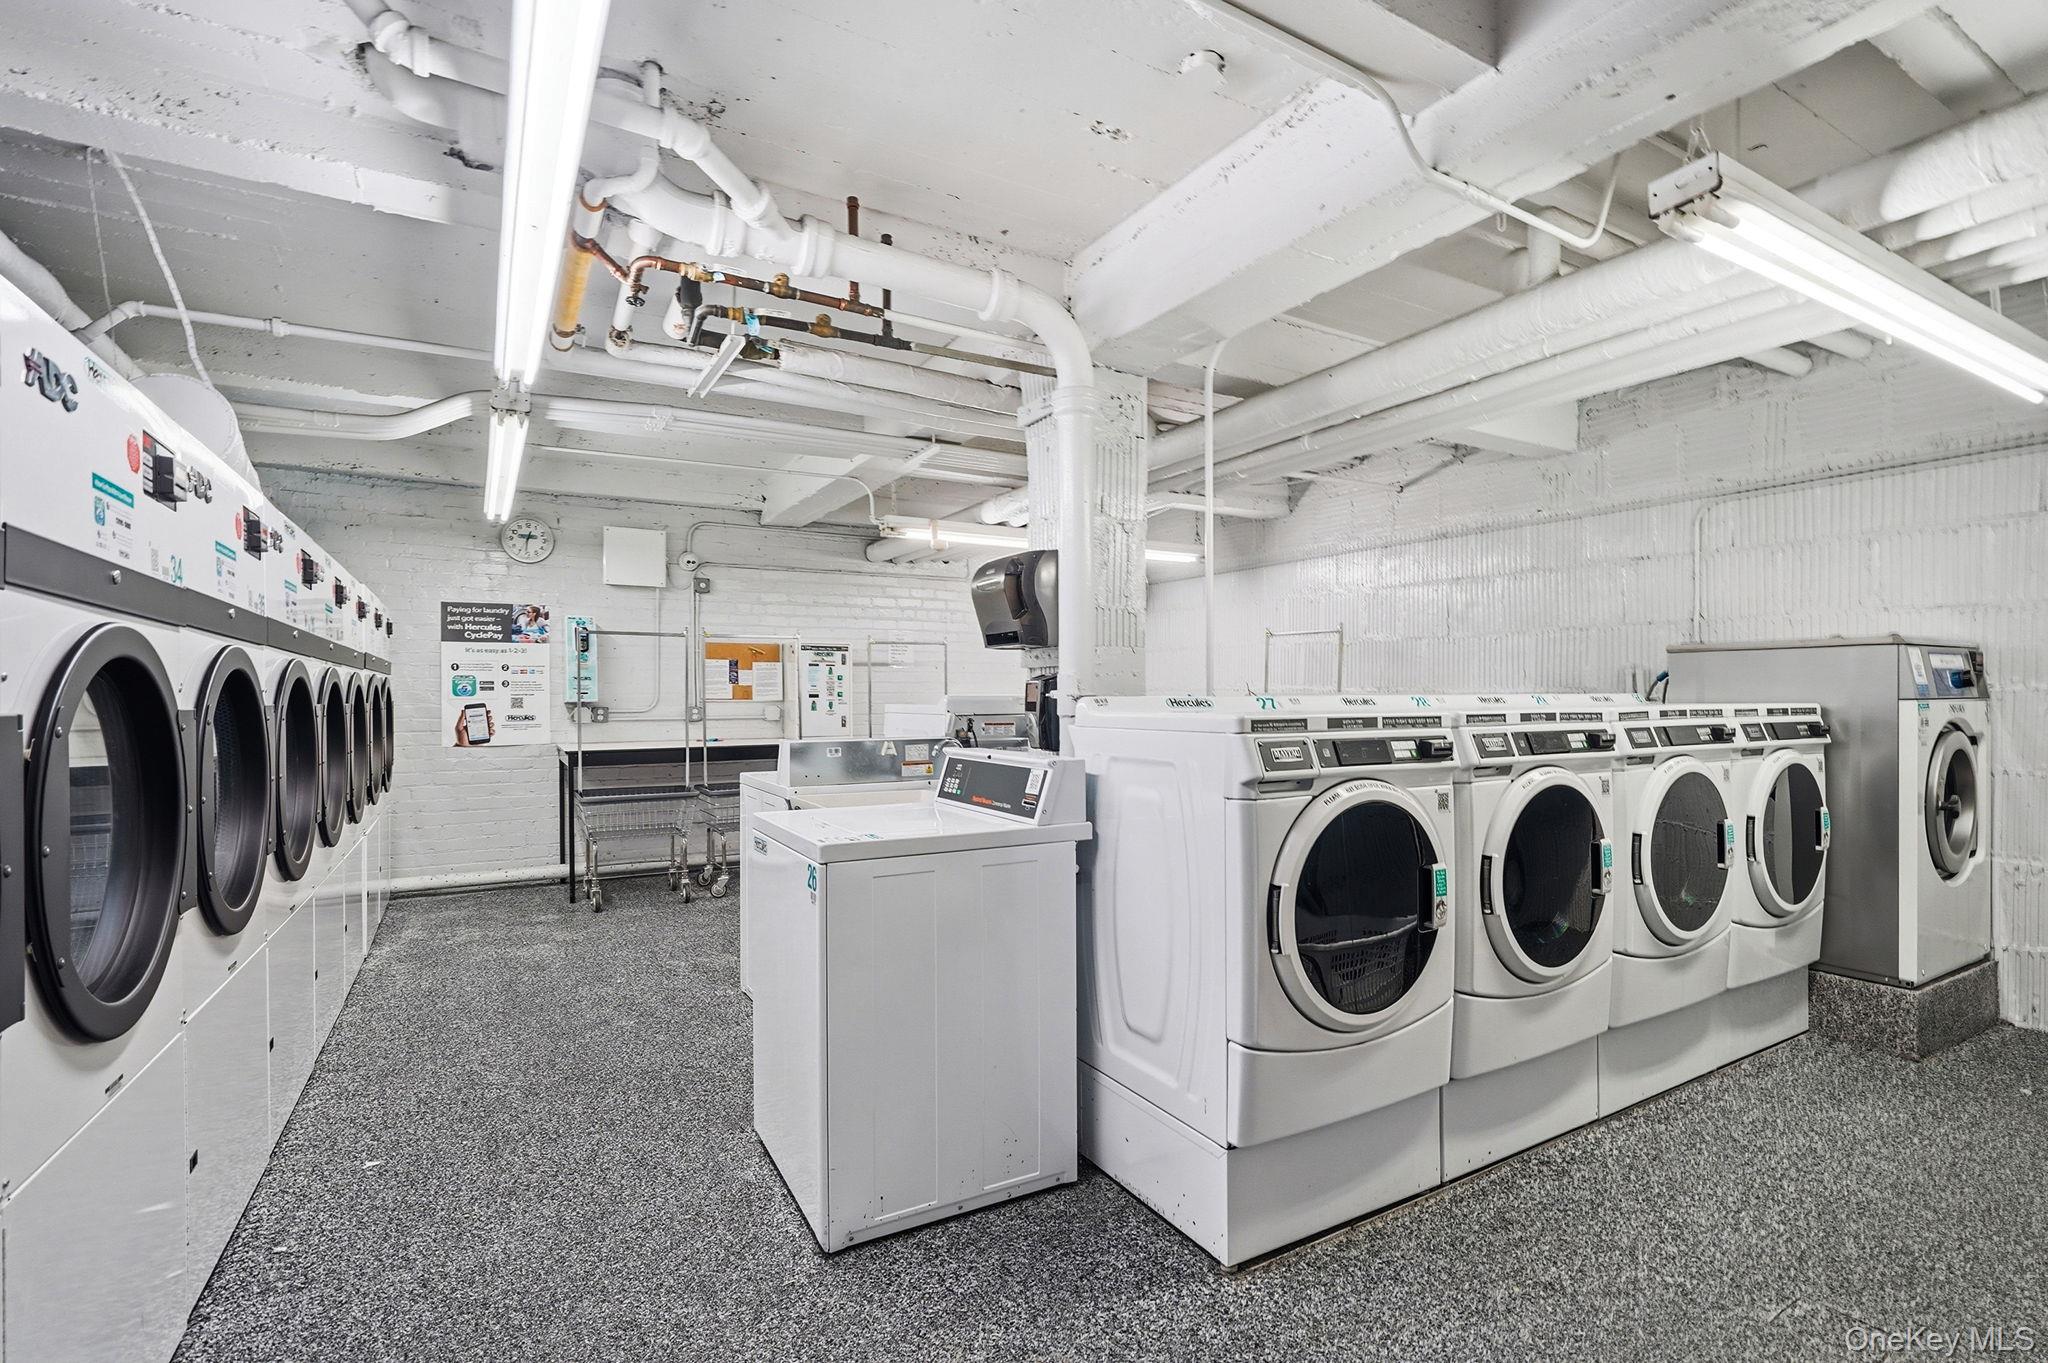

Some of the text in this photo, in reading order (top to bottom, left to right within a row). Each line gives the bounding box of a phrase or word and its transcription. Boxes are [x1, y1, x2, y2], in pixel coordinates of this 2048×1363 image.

[170, 554, 183, 585] 34
[447, 606, 471, 614] Paying
[483, 607, 509, 615] laundry
[464, 631, 503, 640] CyclePay
[1168, 698, 1212, 708] Hercules
[1341, 697, 1377, 706] Hercules
[807, 863, 818, 891] 26
